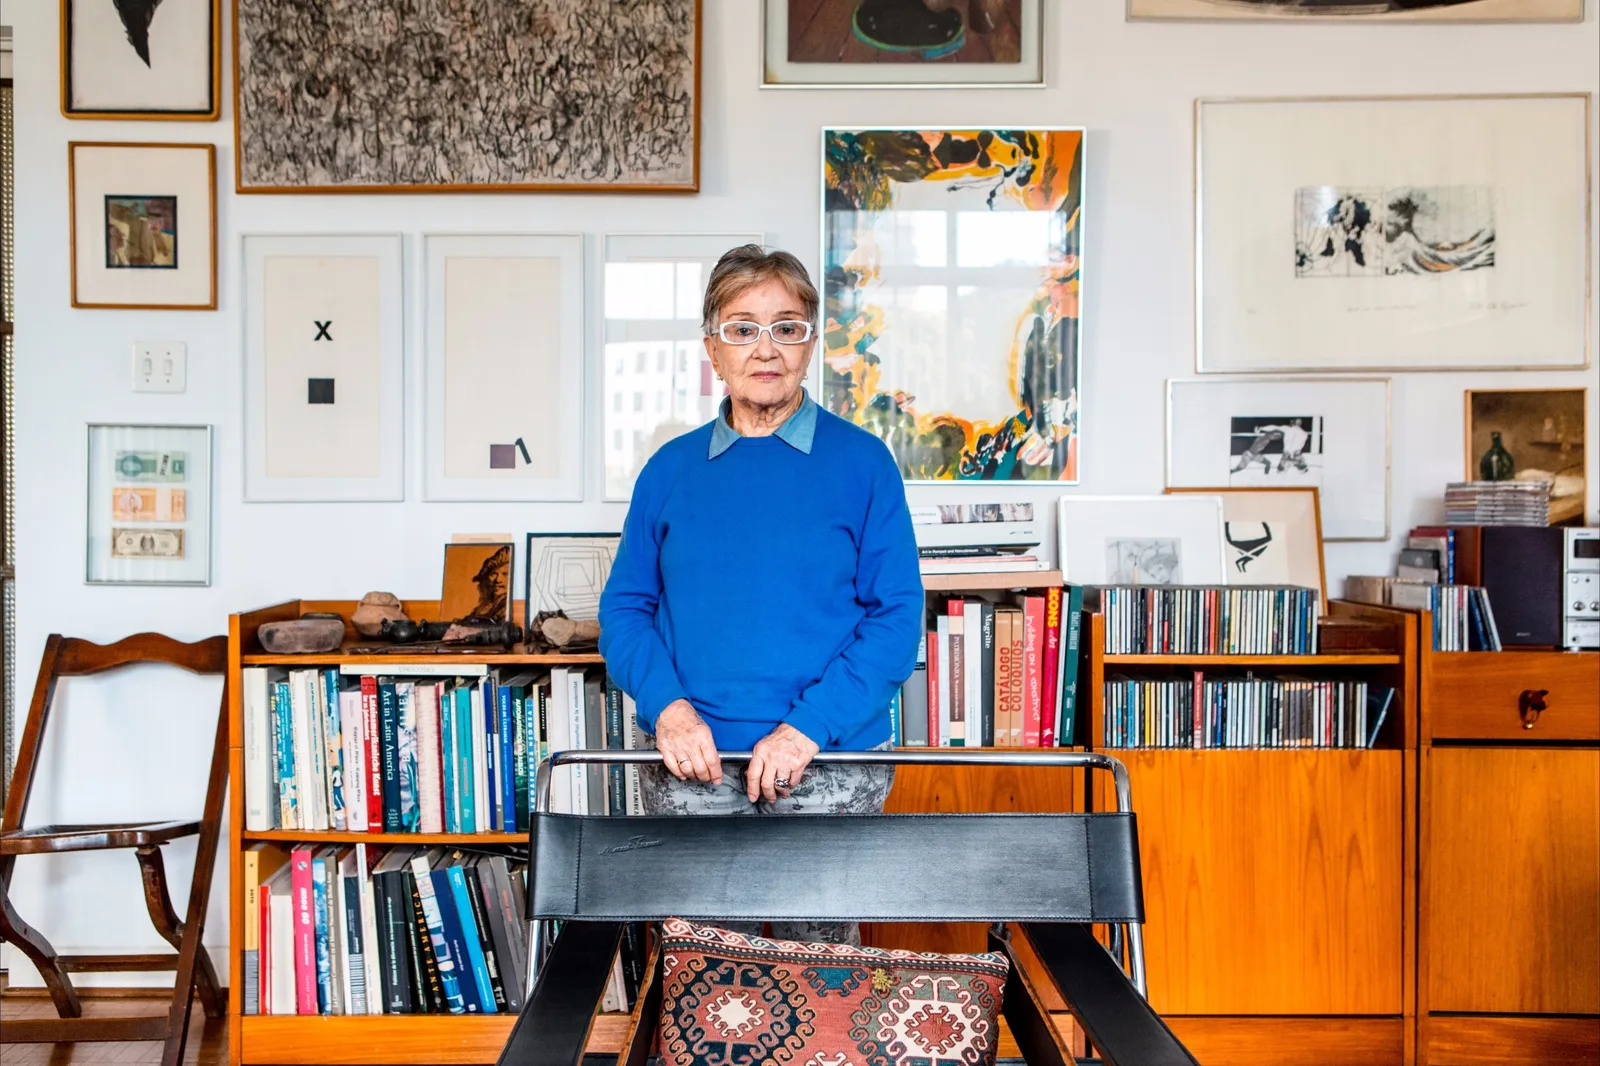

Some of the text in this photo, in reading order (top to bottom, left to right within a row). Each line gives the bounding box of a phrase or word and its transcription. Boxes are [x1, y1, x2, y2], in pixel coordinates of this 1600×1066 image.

[314, 320, 333, 342] X
[1048, 588, 1059, 628] ICONS
[983, 614, 993, 648] Magritte
[1049, 636, 1057, 649] Art
[996, 647, 1010, 712] CATÁLOGO
[1012, 640, 1022, 712] COLOQUIOS
[383, 690, 394, 781] Art in Latin America
[301, 912, 310, 924] 60
[412, 892, 439, 992] ANTE AMERICA
